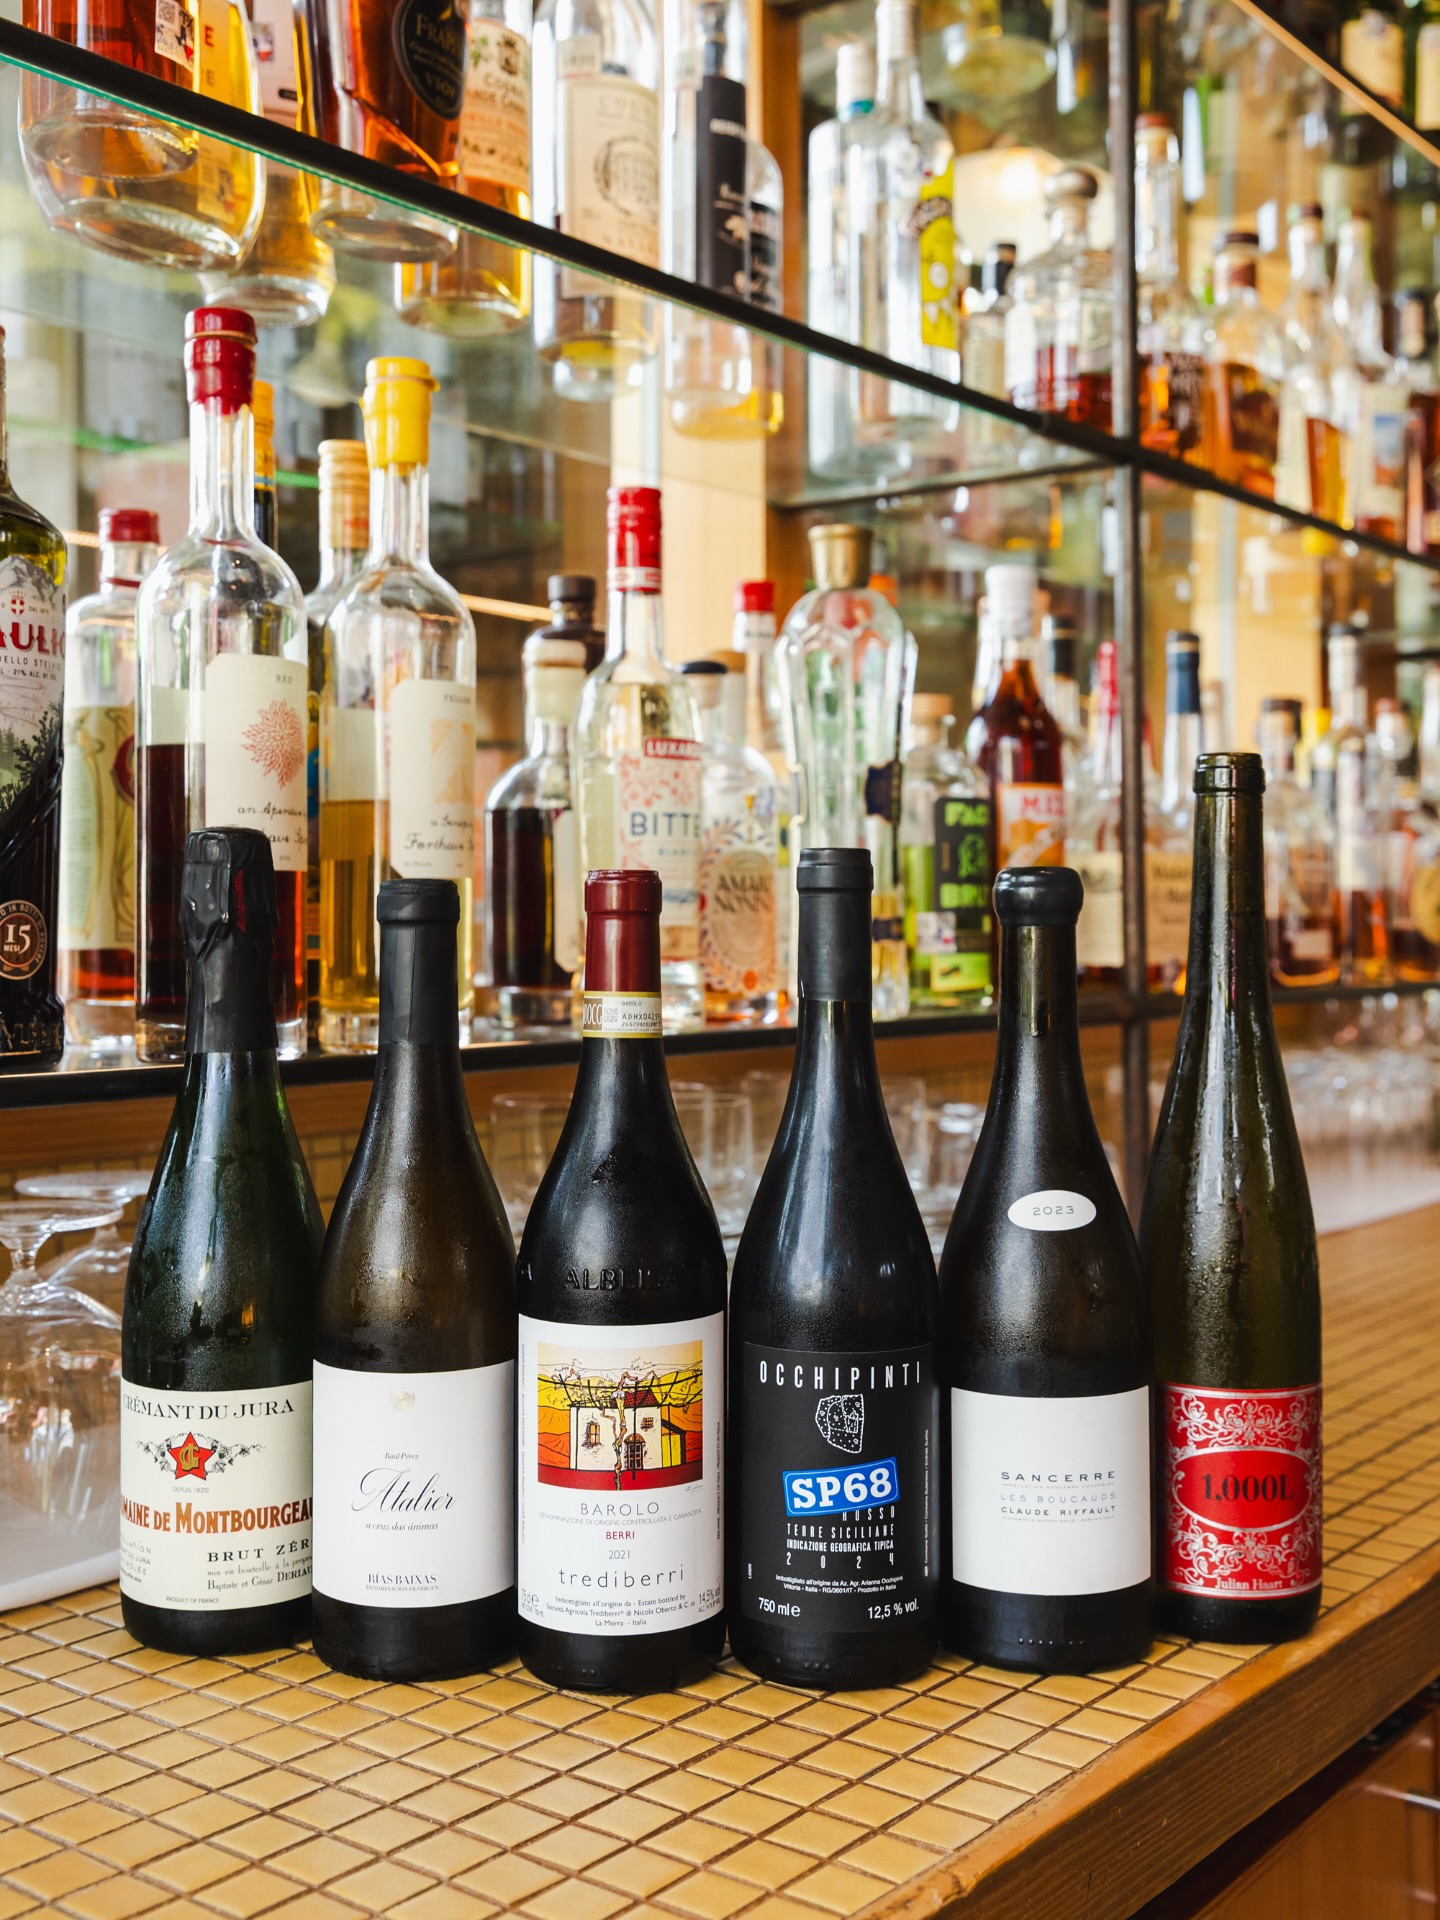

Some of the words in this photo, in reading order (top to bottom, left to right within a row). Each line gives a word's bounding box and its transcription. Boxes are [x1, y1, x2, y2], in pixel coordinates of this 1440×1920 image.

[0, 655, 28, 665] ELLO
[276, 674, 293, 684] RED
[4, 944, 21, 952] MESI
[1032, 1205, 1075, 1216] 2023
[759, 1360, 920, 1390] OCCHIPINTI
[123, 1393, 195, 1419] CRÉMANT
[198, 1405, 228, 1420] DU
[233, 1398, 295, 1418] JURA
[1001, 1470, 1115, 1482] SANCERRE
[351, 1467, 457, 1513] Atalier
[790, 1467, 893, 1509] SP68
[1001, 1492, 1027, 1502] LES
[1037, 1491, 1116, 1503] BOUCAUDS
[121, 1494, 150, 1528] MAINE
[153, 1510, 171, 1532] DE
[580, 1501, 660, 1516] BAROLO
[1001, 1506, 1049, 1516] CLAUDE
[1060, 1505, 1115, 1516] RIFFAULT
[539, 1511, 585, 1525] DENOMINAZIONE
[622, 1516, 668, 1526] CONTROLLATA
[673, 1508, 702, 1521] GARANTITA
[391, 1522, 406, 1531] das
[407, 1522, 439, 1531] ánimas
[787, 1522, 824, 1539] TERRE
[830, 1522, 895, 1540] SICILIANE
[605, 1531, 635, 1540] BERRI
[207, 1548, 264, 1563] BRUT
[276, 1538, 311, 1556] ZÉR
[786, 1538, 828, 1552] INDICAZIONE
[830, 1540, 872, 1552] GEOGRAFICA
[874, 1538, 894, 1550] TIPICA
[608, 1550, 631, 1560] 2021
[207, 1579, 238, 1592] Baptiste
[251, 1576, 273, 1586] César
[277, 1565, 312, 1583] DERIAU
[368, 1571, 393, 1584] RÍAS
[395, 1574, 437, 1585] BAIXAS
[558, 1563, 685, 1588] trediberri
[1215, 1577, 1250, 1590] Julian
[1252, 1578, 1283, 1589] Haart
[166, 1596, 189, 1604] PRODUCT
[555, 1595, 591, 1607] Imbottigliato
[592, 1599, 622, 1609] all'origine
[638, 1599, 657, 1607] Estate
[658, 1594, 678, 1604] bottled
[679, 1593, 686, 1601] by
[758, 1597, 776, 1613] 750
[546, 1603, 564, 1612] Società
[565, 1607, 588, 1616] Agricola
[633, 1607, 654, 1616] Nicola
[655, 1604, 677, 1614] Oberto
[868, 1605, 891, 1620] 12,5
[893, 1603, 903, 1615] %
[904, 1598, 919, 1613] vol.
